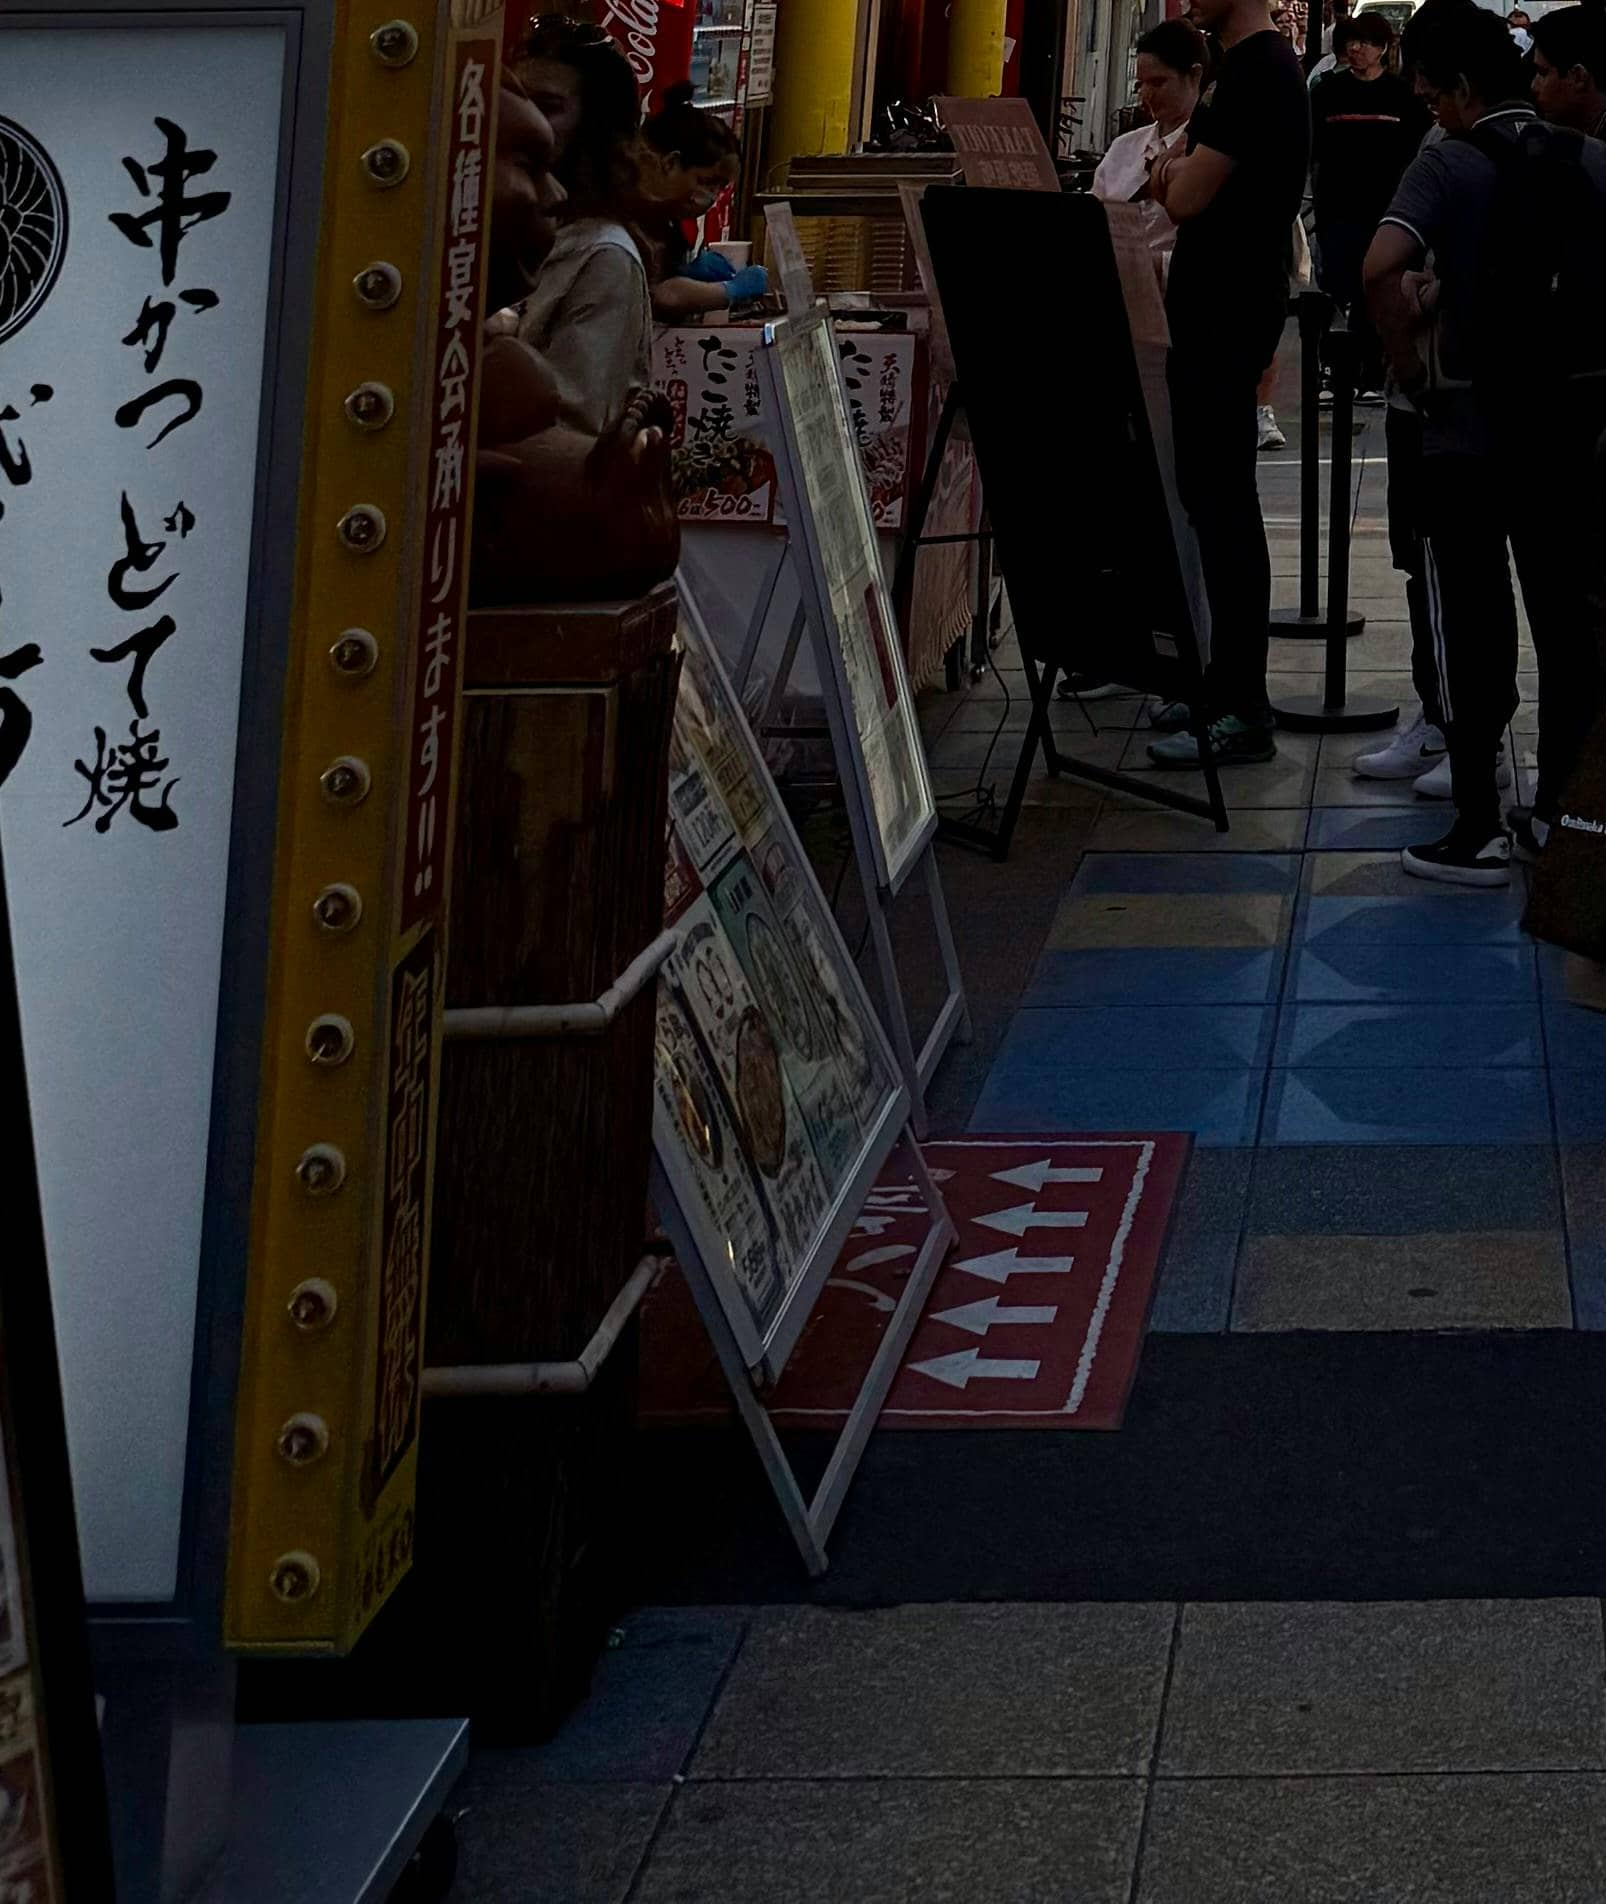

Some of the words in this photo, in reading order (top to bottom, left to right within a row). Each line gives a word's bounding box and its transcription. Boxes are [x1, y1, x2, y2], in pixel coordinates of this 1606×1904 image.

[108, 117, 231, 449] 串かつ
[62, 490, 196, 834] どて焼
